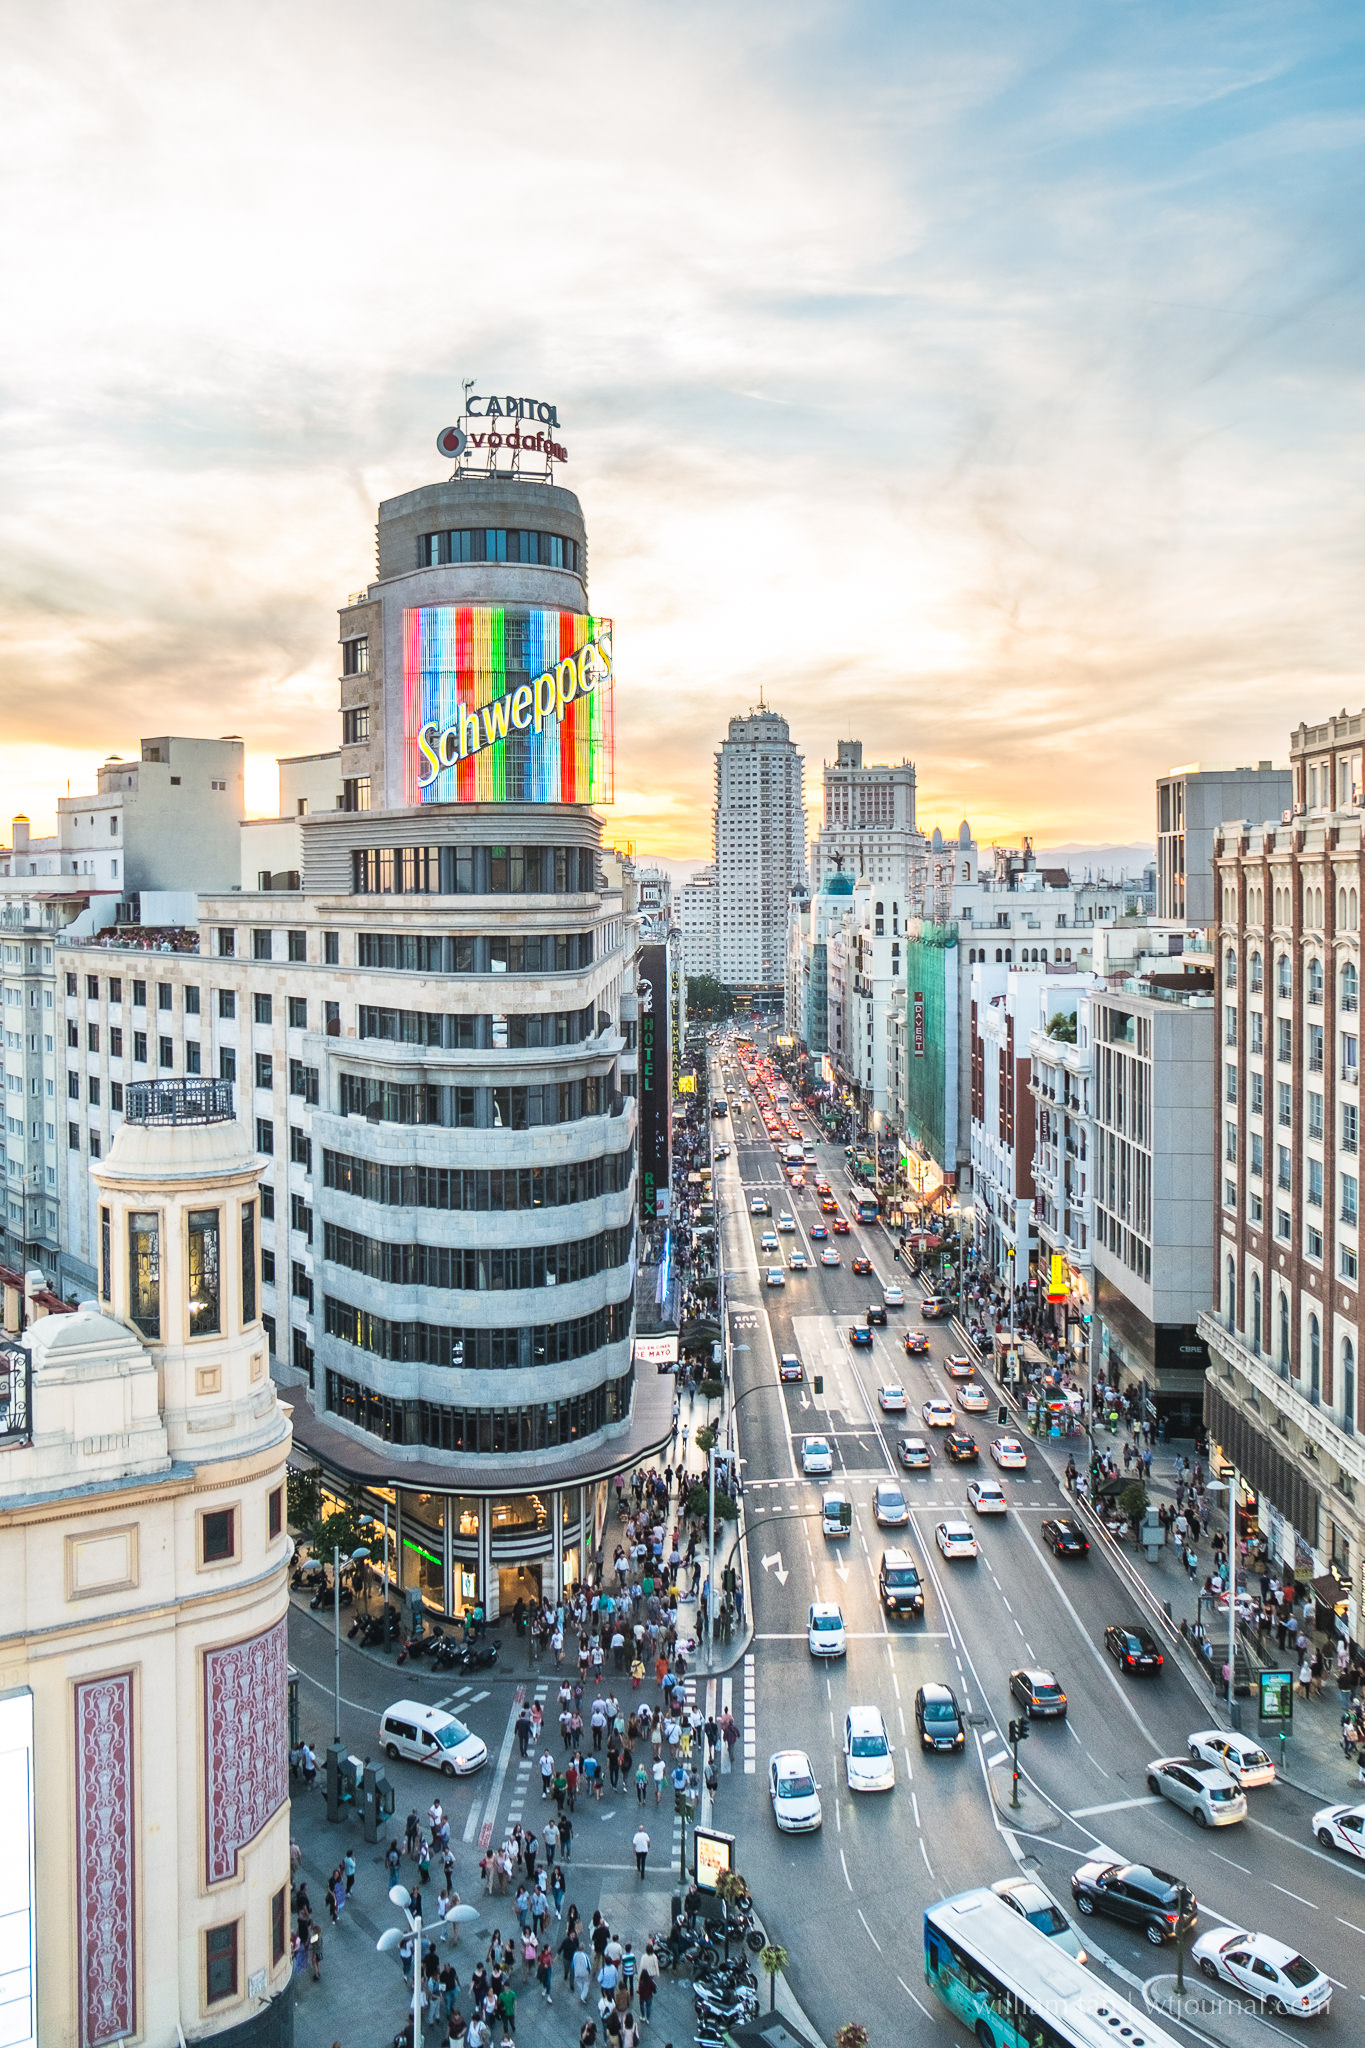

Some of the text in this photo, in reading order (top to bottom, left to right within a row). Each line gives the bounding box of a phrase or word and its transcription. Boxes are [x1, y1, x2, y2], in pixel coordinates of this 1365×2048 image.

[466, 395, 561, 428] CAPITOL
[470, 428, 568, 461] vodafone
[418, 631, 613, 788] Schweppes
[643, 1017, 655, 1215] HOTEL REX
[649, 1349, 671, 1357] MAYO
